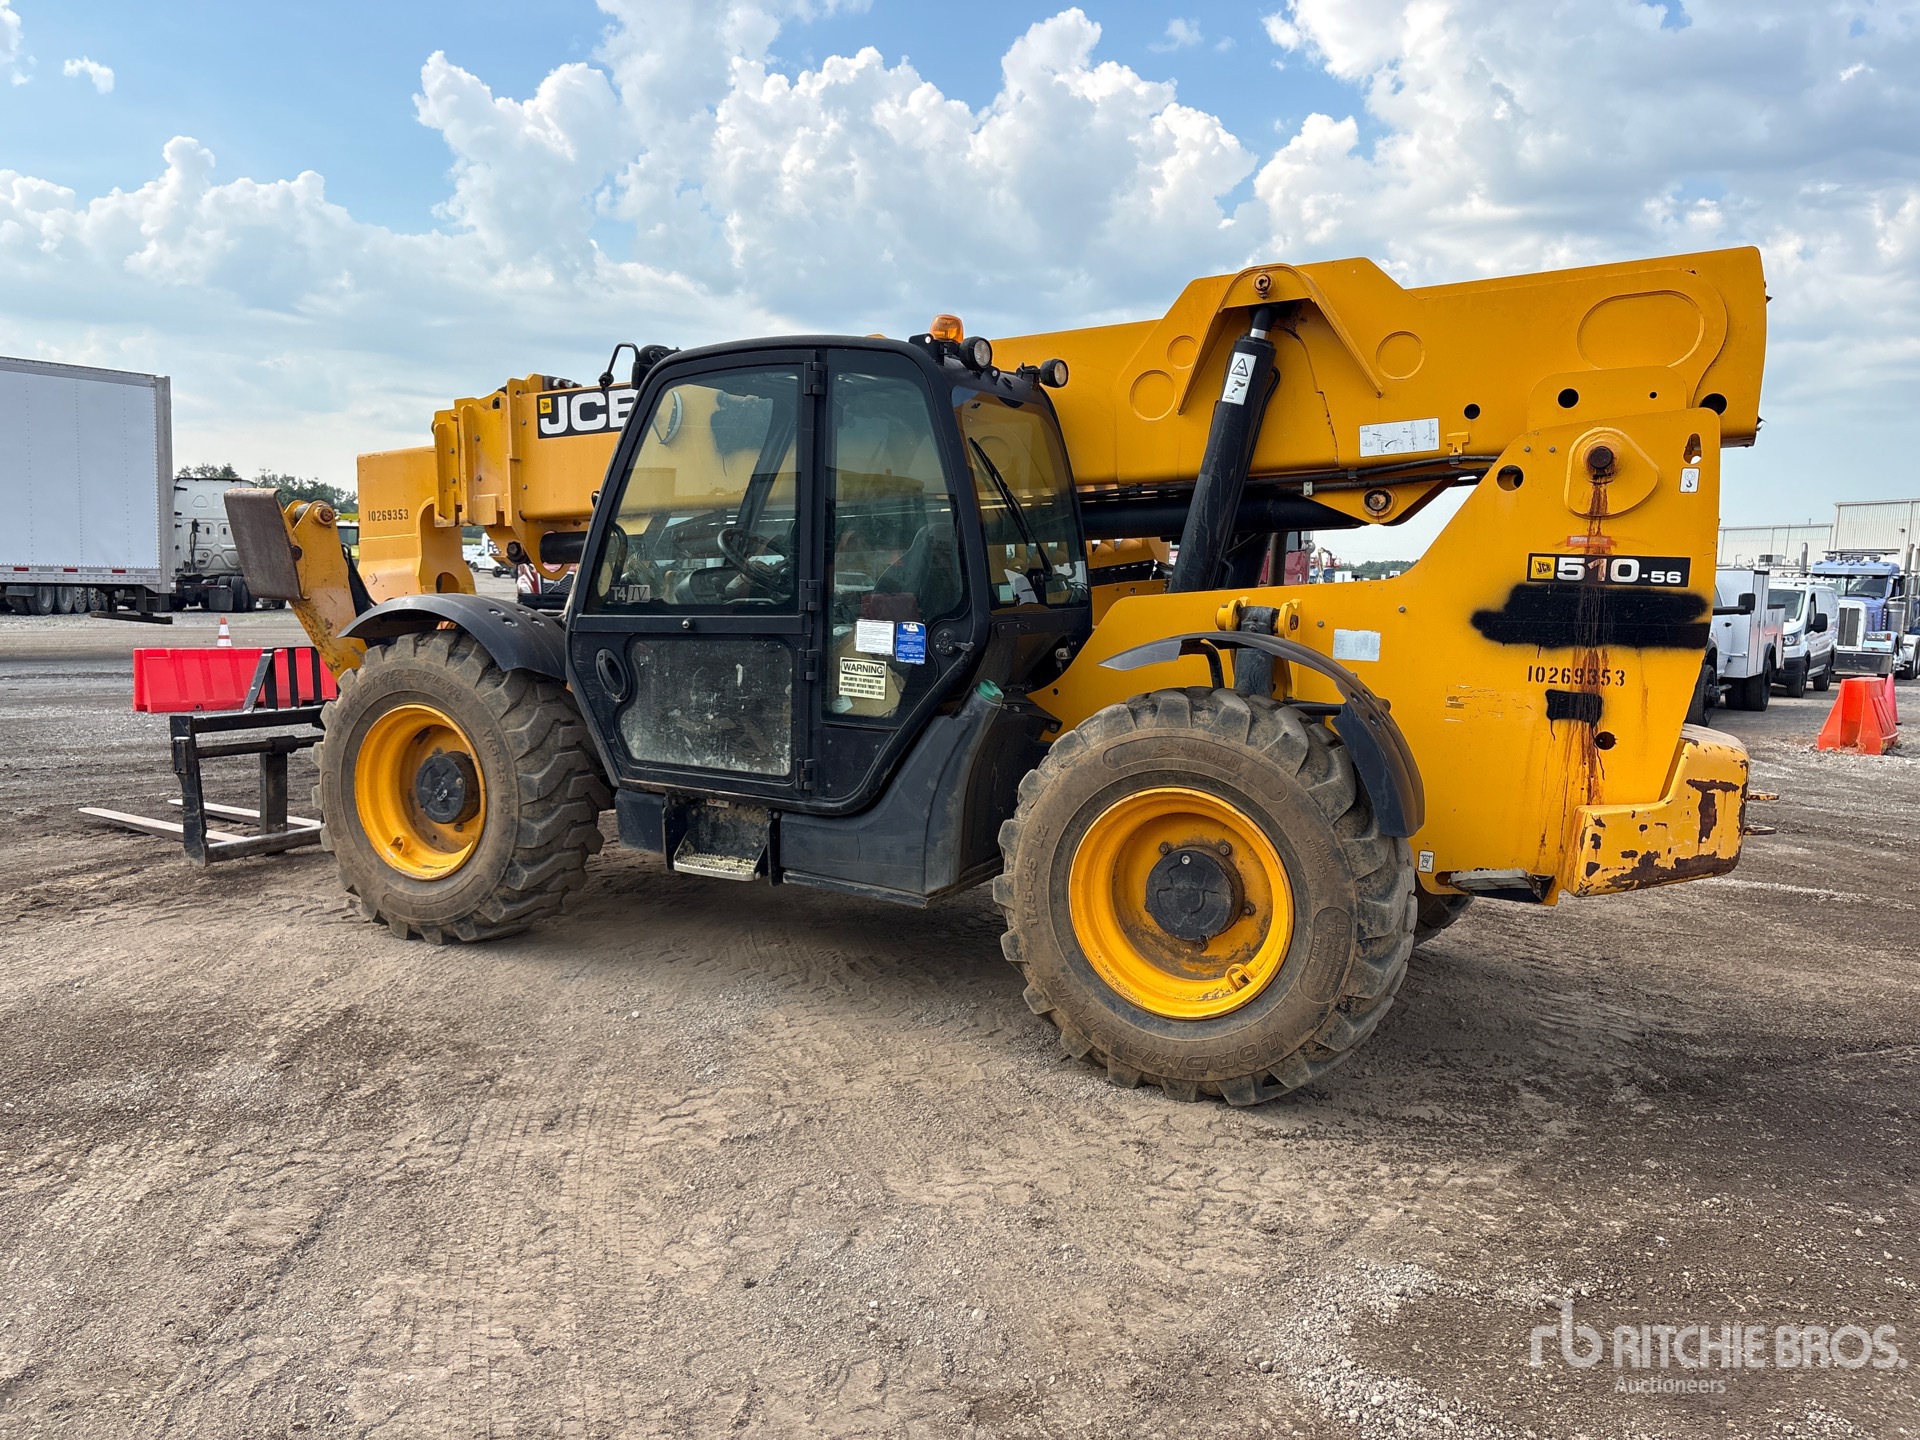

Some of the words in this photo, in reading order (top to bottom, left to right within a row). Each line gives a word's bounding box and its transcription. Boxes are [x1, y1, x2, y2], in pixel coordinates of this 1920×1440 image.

[540, 388, 639, 435] JCB
[368, 508, 409, 522] 10269353
[1535, 560, 1553, 575] JCB
[1557, 557, 1682, 583] 510-56
[610, 586, 627, 601] T4
[843, 662, 883, 675] WARNING
[1527, 665, 1626, 687] 10269353
